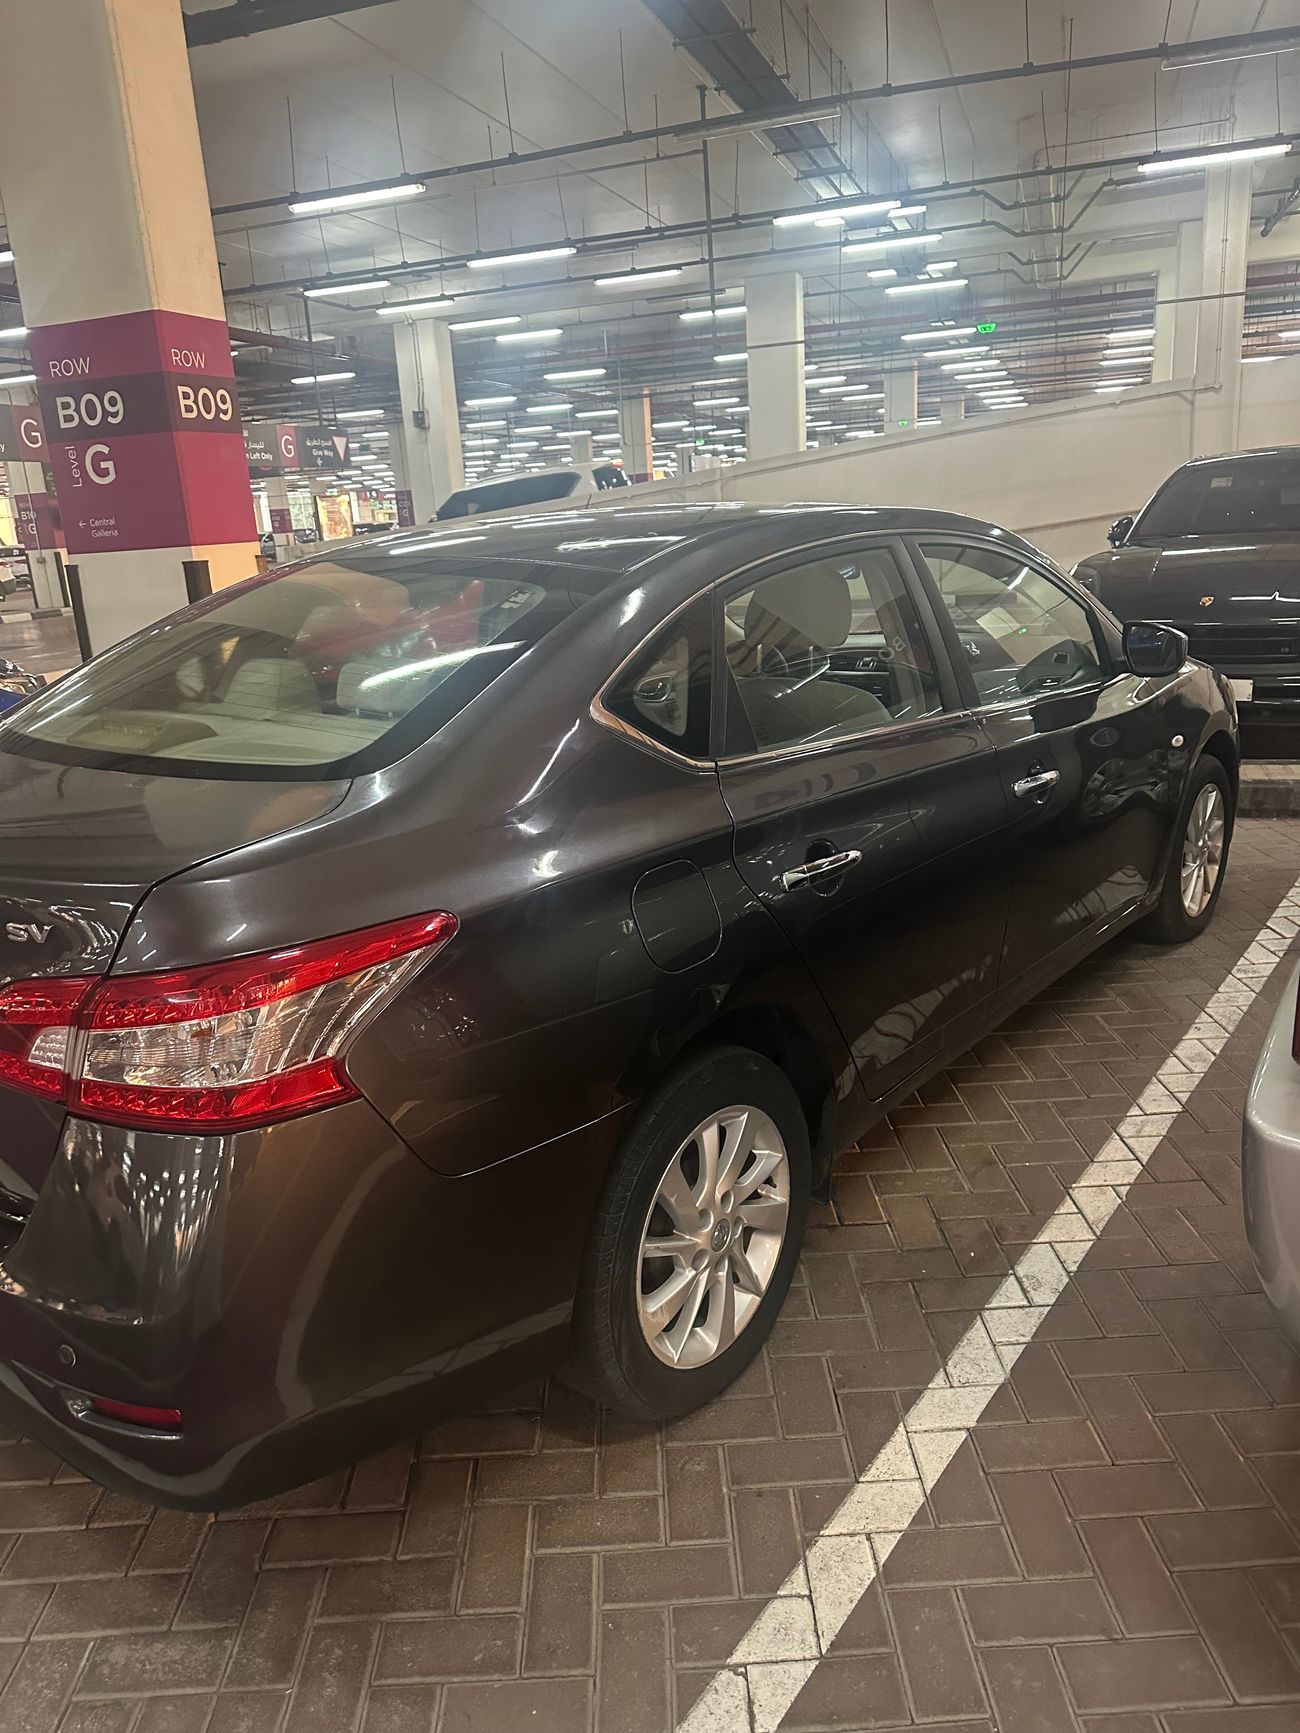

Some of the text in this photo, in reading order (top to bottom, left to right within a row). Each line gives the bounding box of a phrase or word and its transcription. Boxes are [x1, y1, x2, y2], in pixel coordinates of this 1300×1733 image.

[49, 356, 90, 378] ROW
[171, 348, 205, 368] ROW
[56, 389, 125, 429] B09
[177, 385, 233, 421] B09
[20, 418, 43, 448] G
[281, 435, 295, 458] G
[64, 445, 83, 487] Level
[84, 443, 117, 485] G
[28, 523, 37, 534] G
[89, 516, 116, 527] Central
[91, 528, 118, 538] Galleria
[6, 922, 53, 944] SV
